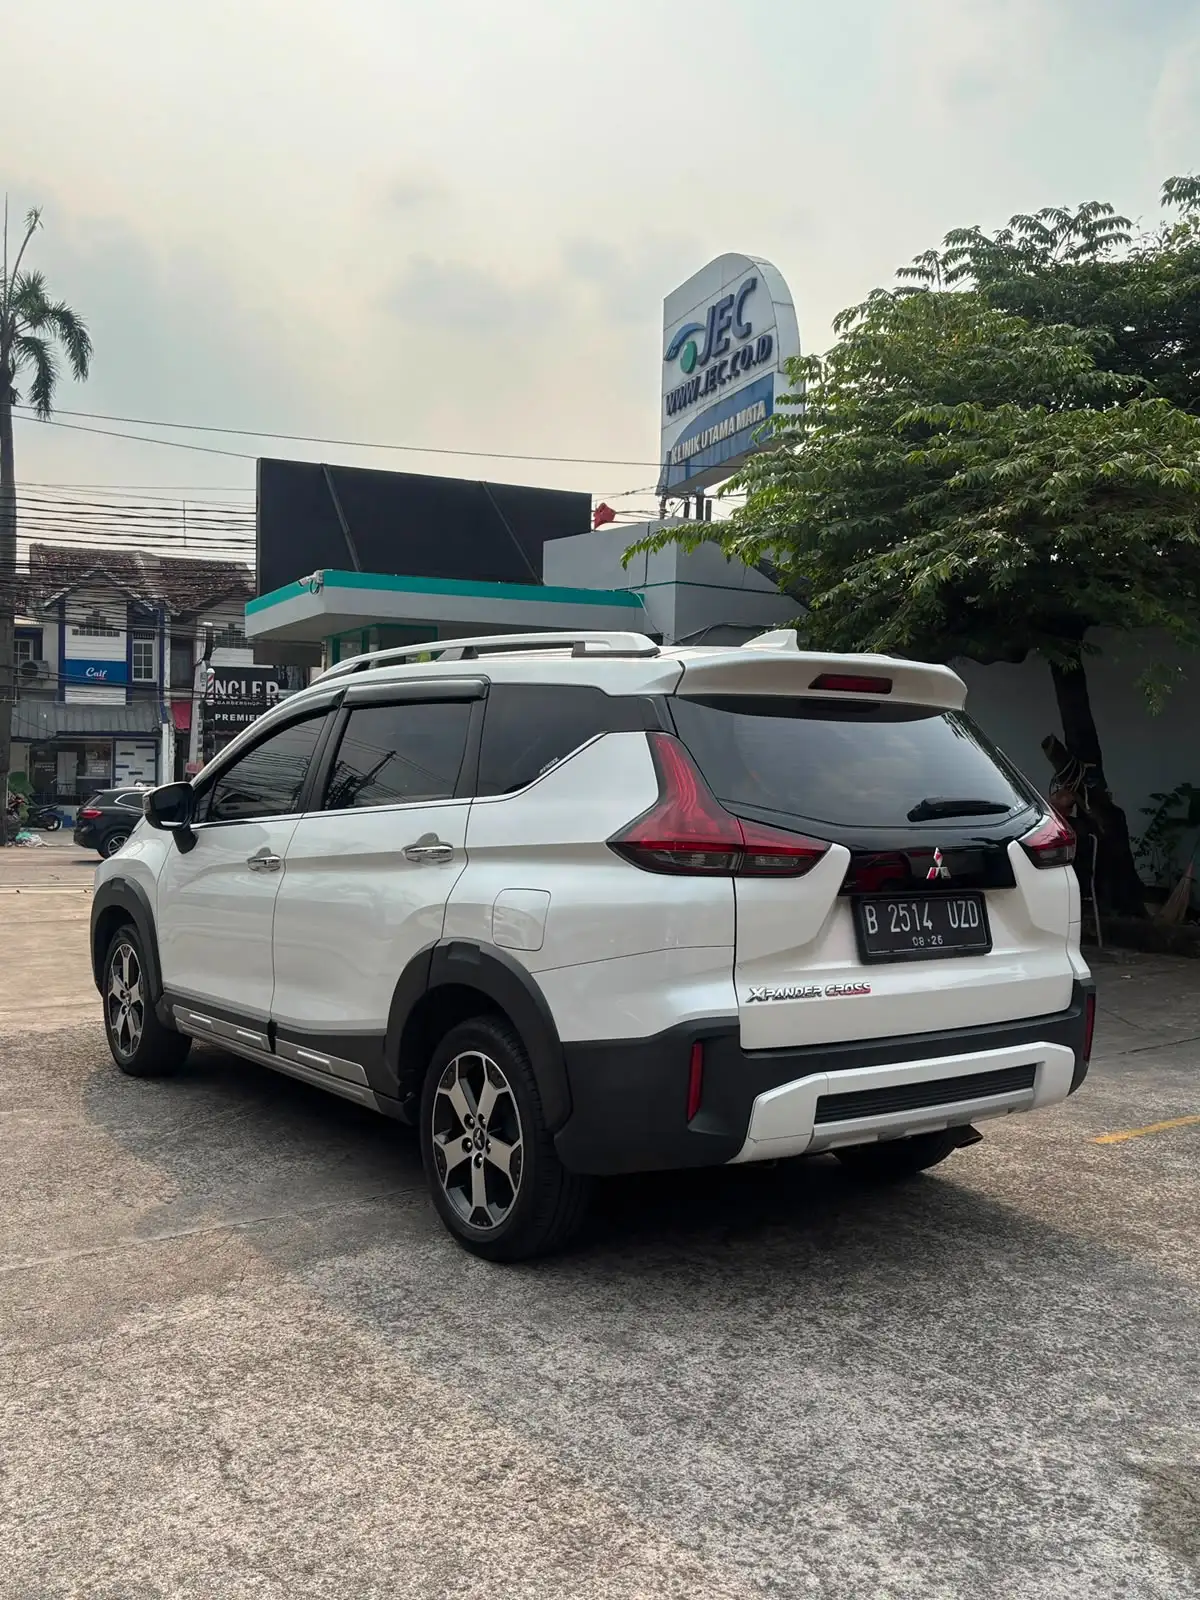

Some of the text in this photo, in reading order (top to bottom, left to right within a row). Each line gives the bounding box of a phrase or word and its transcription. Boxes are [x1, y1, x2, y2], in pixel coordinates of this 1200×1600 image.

[697, 277, 757, 366] JEC
[666, 335, 773, 416] WWW.JEC.CO.ID
[671, 400, 766, 465] KLINIK UTAMA MATA
[864, 900, 979, 934] B 2514 UZD
[746, 982, 872, 1003] XPANDER CROSS
